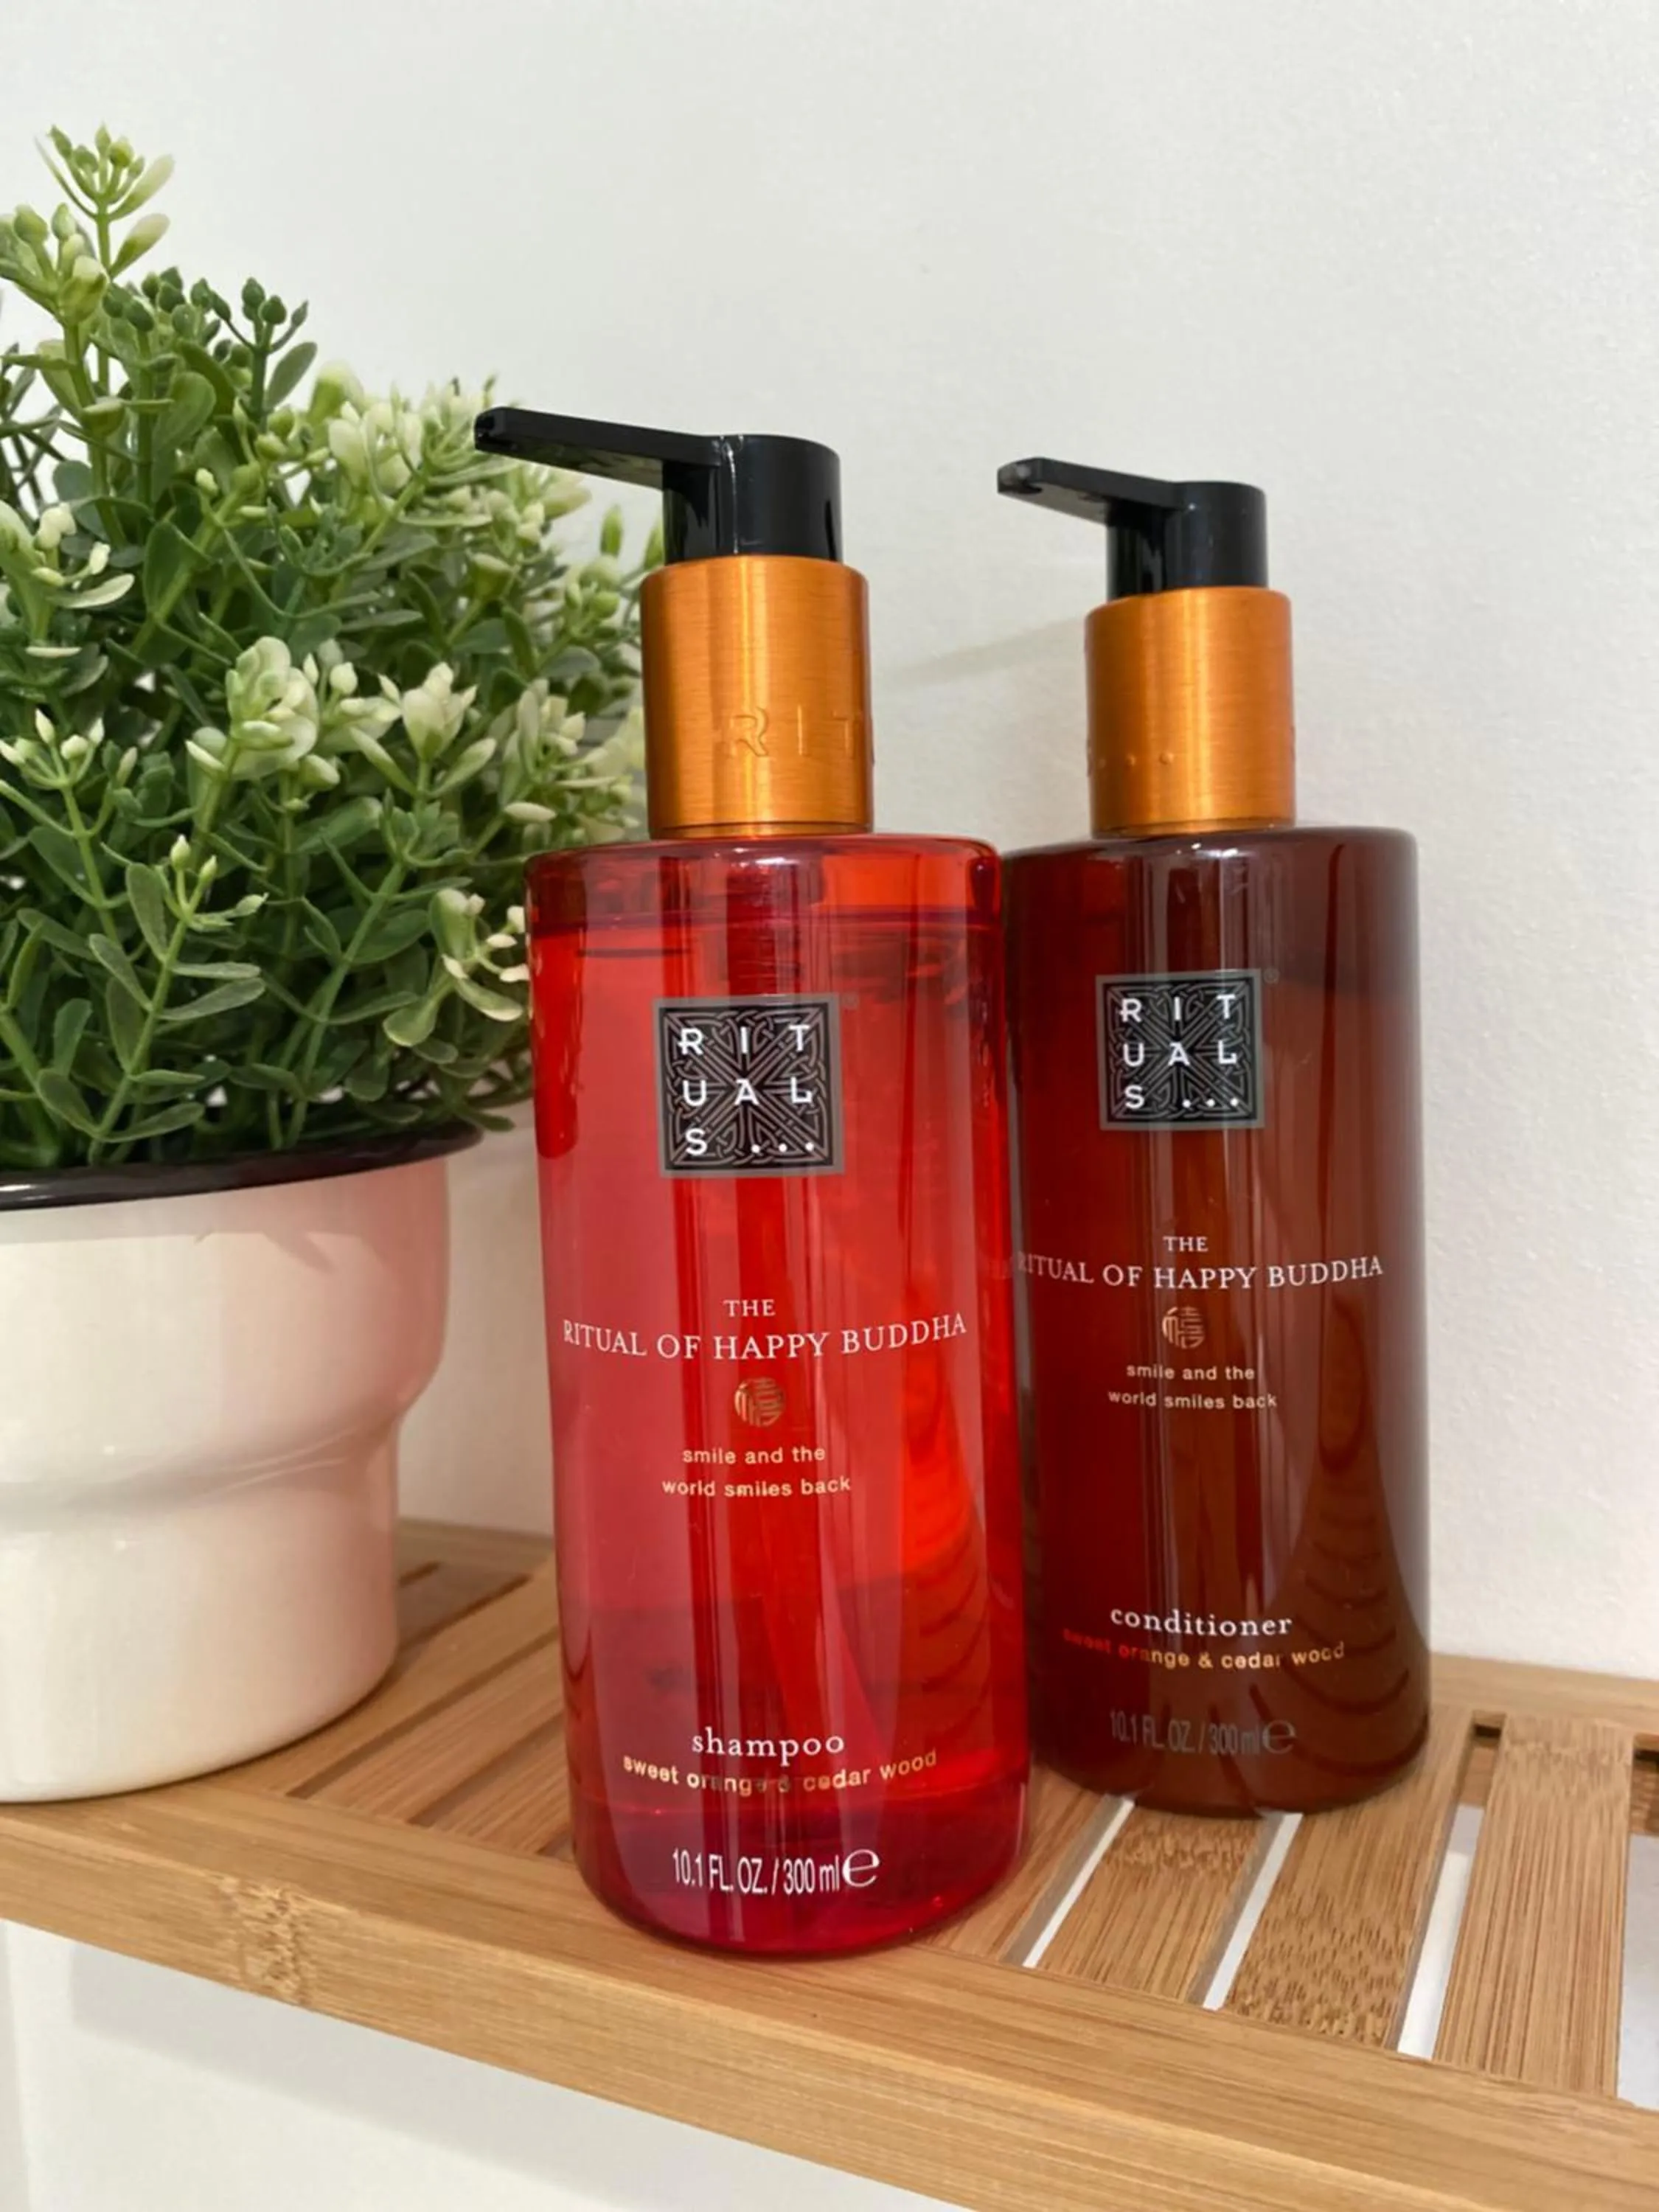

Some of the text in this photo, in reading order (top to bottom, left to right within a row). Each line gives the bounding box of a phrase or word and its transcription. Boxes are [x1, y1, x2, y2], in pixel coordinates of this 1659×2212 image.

[1163, 1236, 1208, 1252] THE
[1017, 1251, 1383, 1289] RITUAL OF HAPPY BUDDHA
[723, 1299, 776, 1317] THE
[563, 1312, 967, 1360] RITUAL OF HAPPY BUDDHA
[1127, 1363, 1255, 1381] smile and the
[1107, 1391, 1277, 1409] world smiles back
[683, 1446, 826, 1464] smile and the
[662, 1476, 851, 1497] world smiles back
[1110, 1608, 1293, 1637] conditioner
[1119, 1645, 1189, 1669] orange
[1198, 1652, 1213, 1669] &
[1221, 1652, 1283, 1669] cedar
[1292, 1641, 1345, 1666] wood
[1110, 1708, 1137, 1745] 10.1
[1208, 1722, 1239, 1755] 300
[692, 1727, 845, 1767] shampoo
[623, 1756, 678, 1784] sweet
[803, 1767, 871, 1790] cedar
[880, 1750, 936, 1780] wood
[672, 1848, 703, 1888] 10.1
[709, 1854, 734, 1891] FL.
[738, 1857, 768, 1894] OZ.
[771, 1857, 780, 1896] /
[783, 1858, 815, 1895] 300
